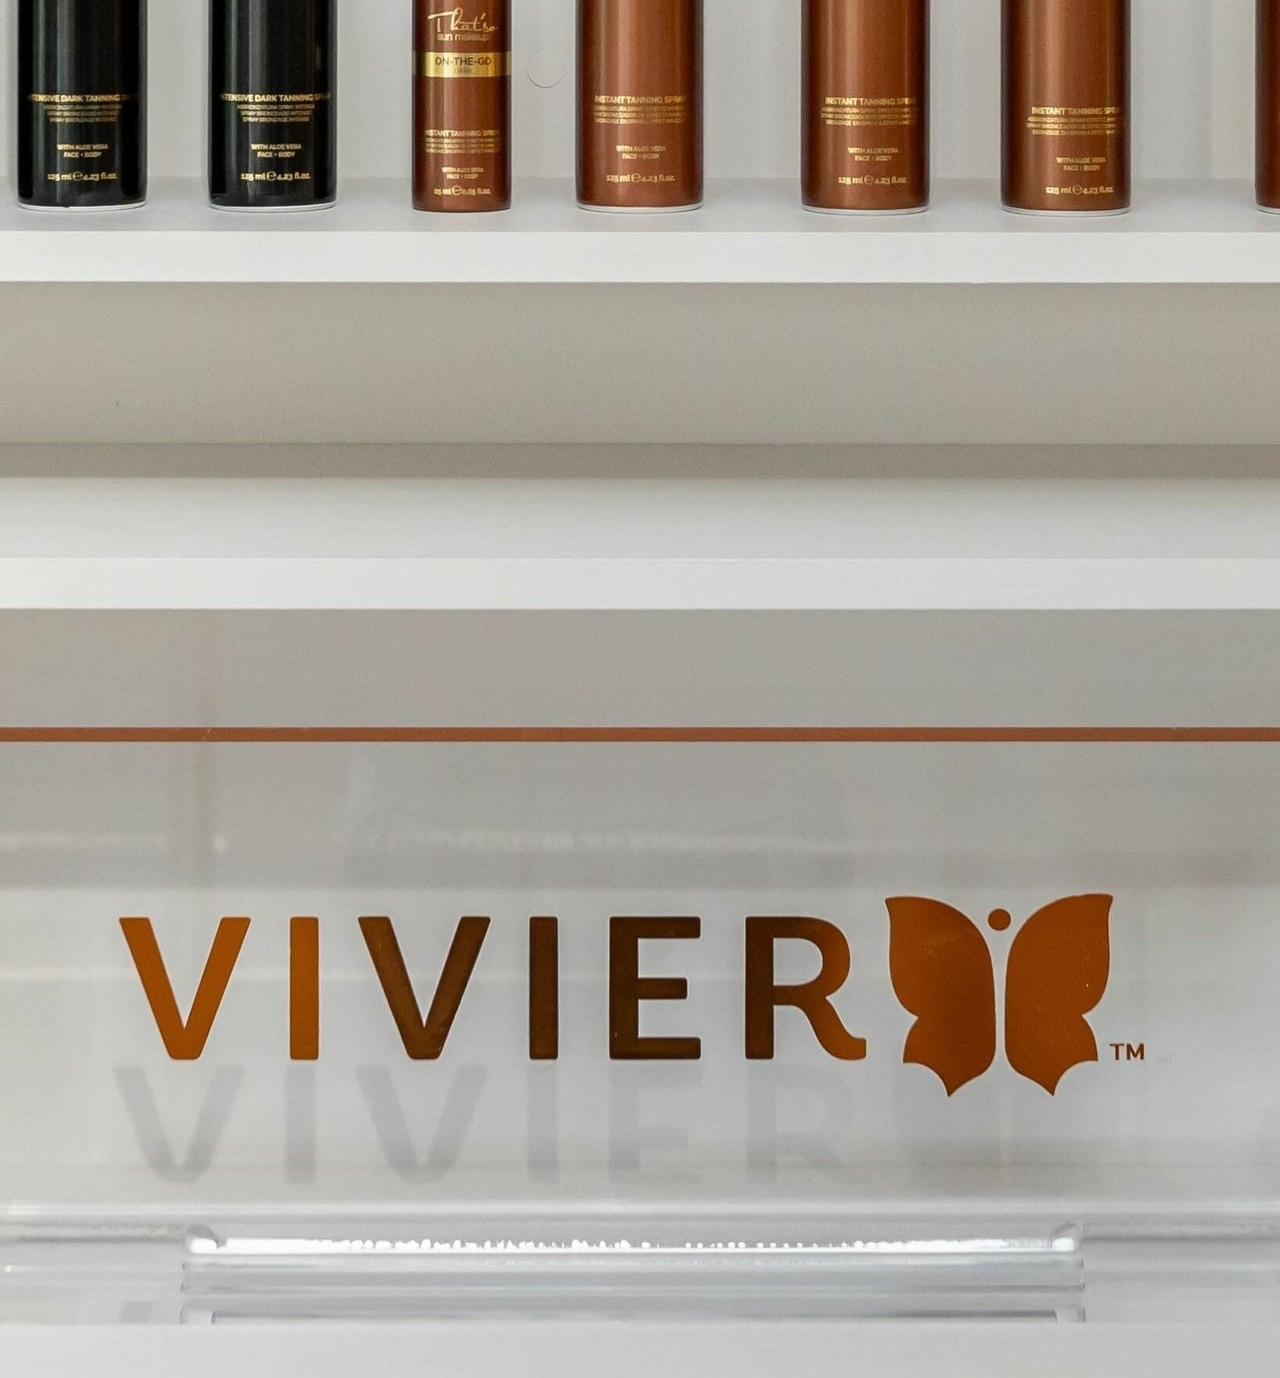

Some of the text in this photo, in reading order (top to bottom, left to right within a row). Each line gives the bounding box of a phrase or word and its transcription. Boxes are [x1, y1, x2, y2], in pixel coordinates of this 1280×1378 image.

[435, 57, 492, 66] ON-THE-GO
[61, 94, 121, 102] DARK TANNING
[255, 93, 313, 102] DARK TANNING
[825, 97, 896, 105] INSTANT TANNING
[1032, 107, 1103, 115] INSTANT TANNING
[118, 914, 867, 1061] VIVIER
[1109, 1042, 1146, 1064] TM
